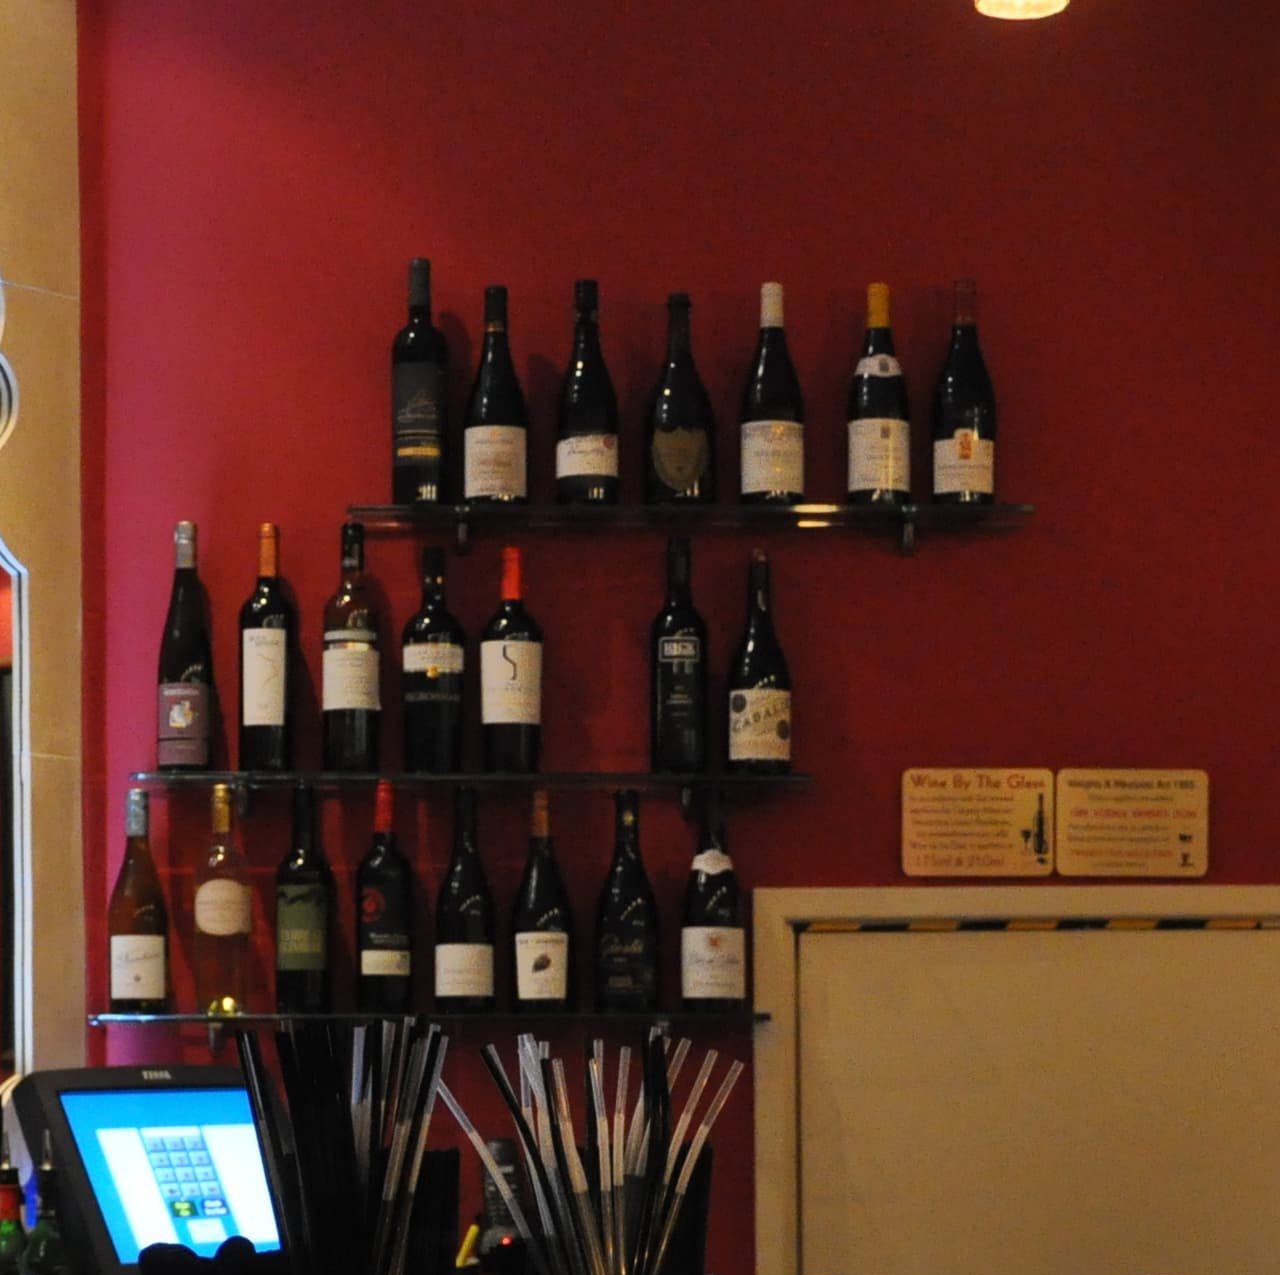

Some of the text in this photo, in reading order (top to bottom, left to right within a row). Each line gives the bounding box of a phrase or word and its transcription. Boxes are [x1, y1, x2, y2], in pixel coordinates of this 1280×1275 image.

[910, 774, 1045, 790] Wine By The Glass
